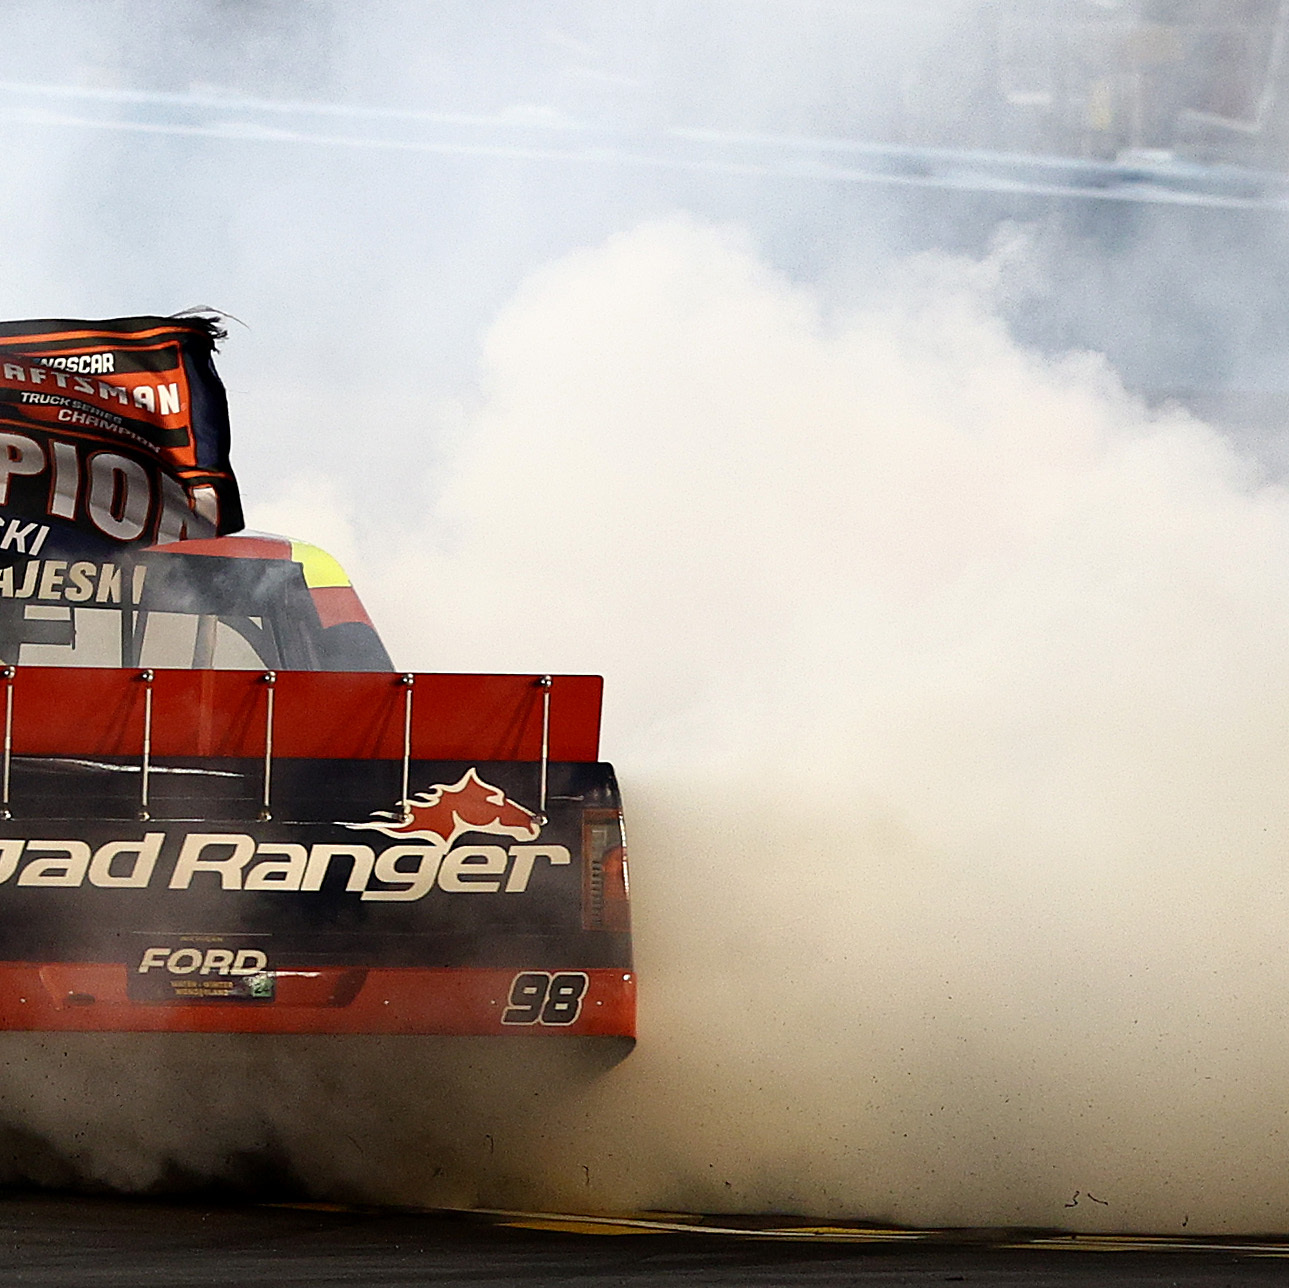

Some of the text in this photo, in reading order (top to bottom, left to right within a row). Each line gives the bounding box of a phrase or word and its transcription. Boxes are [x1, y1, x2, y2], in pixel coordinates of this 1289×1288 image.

[39, 352, 115, 374] NASCAR
[21, 391, 123, 424] TRUCK SERIES
[58, 408, 161, 454] CHAMPION
[168, 832, 571, 902] Ranger
[138, 947, 268, 976] FORD
[500, 971, 590, 1027] 98
